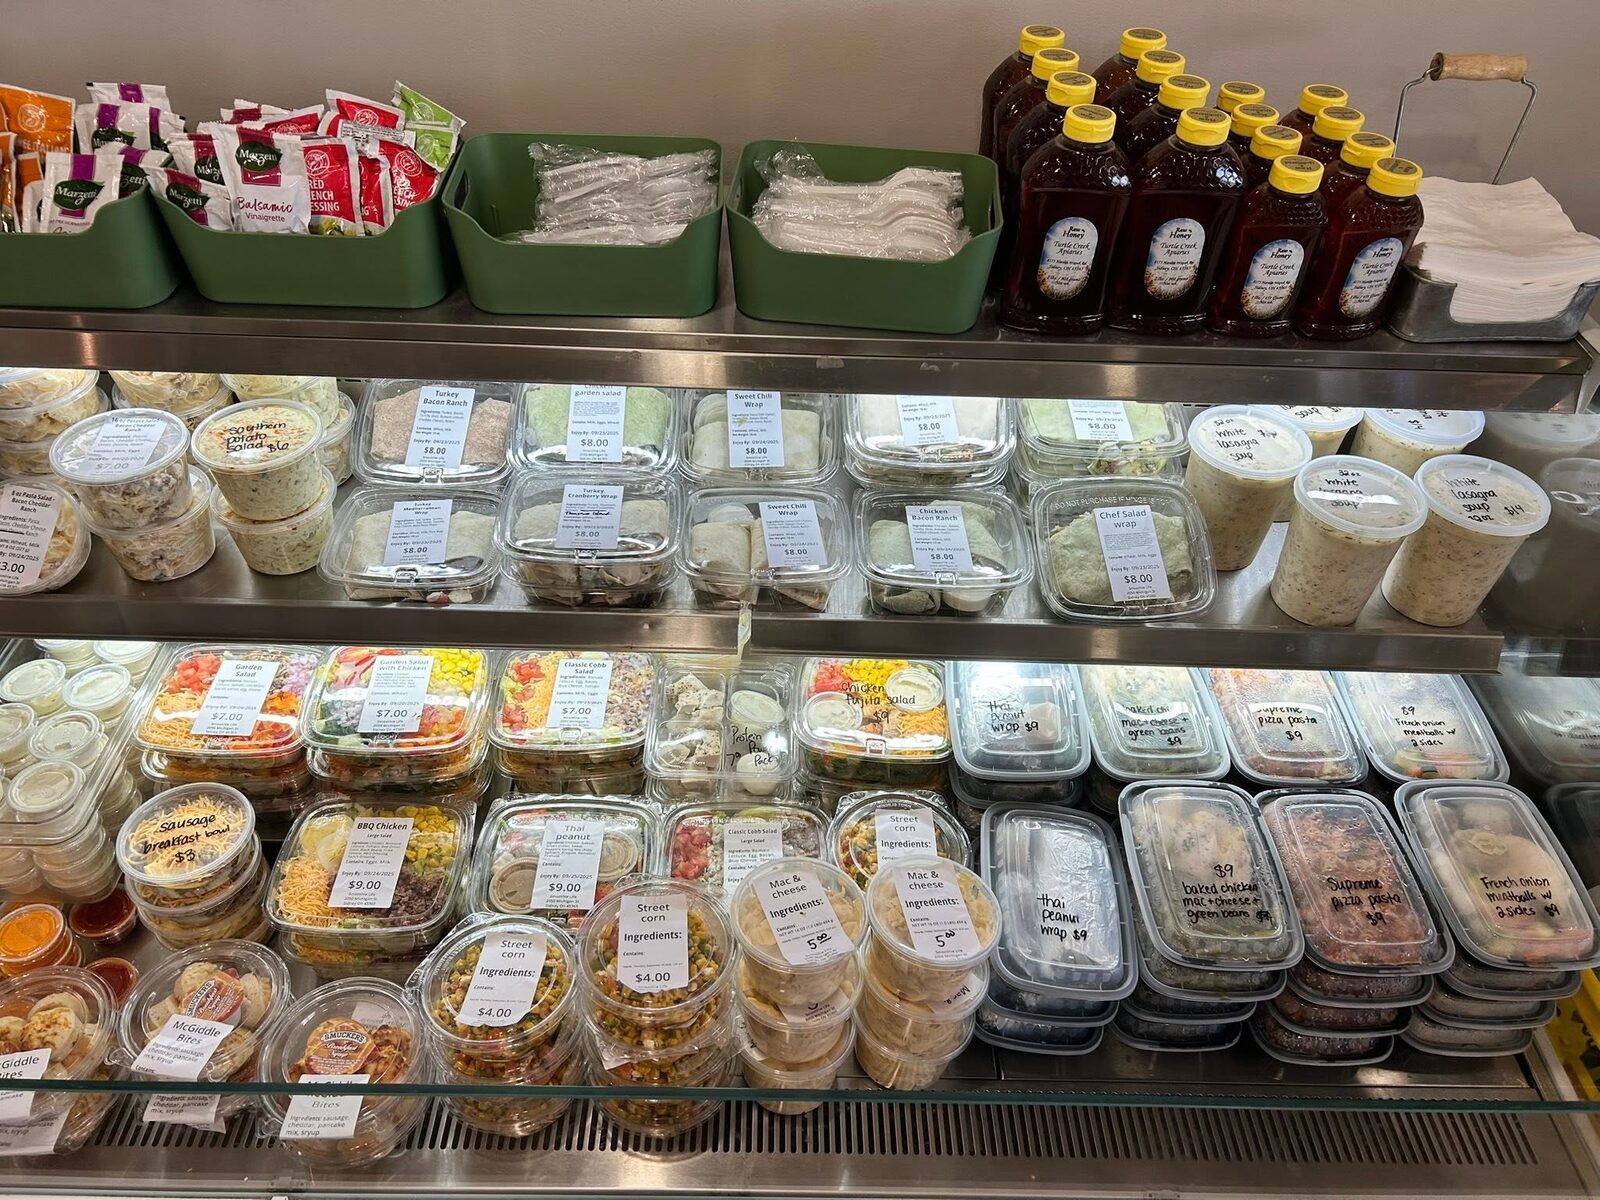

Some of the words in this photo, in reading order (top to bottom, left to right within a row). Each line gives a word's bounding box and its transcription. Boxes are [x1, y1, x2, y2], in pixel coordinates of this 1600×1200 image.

[239, 149, 277, 166] Marzetti
[309, 180, 324, 189] RED
[56, 186, 97, 205] Marzetti
[169, 189, 202, 208] Marzetti
[236, 197, 293, 213] Balsamic
[246, 213, 285, 222] Vinaigrette
[1063, 231, 1085, 239] Honey
[1054, 241, 1071, 249] Turtle
[1271, 251, 1292, 259] Honey
[1295, 407, 1322, 419] soup
[918, 422, 941, 431] $8.00
[227, 433, 267, 449] potato
[581, 438, 609, 447] $8.00
[1216, 438, 1260, 450] lasagna
[227, 442, 263, 453] salad
[267, 441, 289, 453] $6
[424, 447, 446, 455] $8.00
[1230, 452, 1255, 461] soup
[1446, 478, 1480, 487] White
[1451, 489, 1498, 501] lasagna
[28, 499, 51, 508] Cheddar
[1330, 500, 1360, 509] soup
[1462, 502, 1491, 512] soup
[1100, 511, 1120, 520] Chef
[1123, 510, 1146, 518] Salad
[886, 695, 916, 705] salad
[376, 710, 408, 718] $7.00
[562, 707, 591, 715] $7.00
[211, 713, 243, 721] $7.00
[1258, 716, 1284, 727] pizza
[1288, 716, 1318, 727] pasta
[1395, 718, 1421, 726] French
[1025, 721, 1039, 732] $9
[1167, 736, 1182, 746] $9
[1285, 731, 1303, 741] $9
[1411, 739, 1418, 747] 2
[160, 814, 216, 833] sausage
[889, 815, 920, 823] Street
[376, 822, 408, 830] Chicken
[894, 824, 917, 832] corn
[143, 832, 200, 854] breakfast
[205, 825, 230, 837] bowl
[880, 839, 932, 849] Ingredients:
[174, 849, 196, 863] $3
[769, 880, 791, 888] Mac
[793, 874, 802, 882] &
[907, 872, 928, 880] Mac
[348, 881, 381, 890] $9.00
[548, 883, 581, 893] $9.00
[909, 881, 944, 890] cheese
[1182, 881, 1218, 894] baked
[1221, 882, 1258, 893] chicken
[1480, 876, 1518, 890] French
[1520, 876, 1550, 887] onion
[772, 884, 807, 899] cheese
[905, 898, 960, 909] Ingredients:
[1331, 896, 1363, 912] pizza
[1368, 892, 1402, 910] pasta
[637, 904, 670, 912] Street
[769, 898, 824, 919] Ingredients:
[1496, 906, 1505, 918] 2
[1506, 905, 1536, 916] sides
[641, 914, 666, 922] corn
[1187, 909, 1219, 923] green
[1220, 910, 1250, 918] beans
[624, 931, 682, 943] Ingredients:
[1040, 925, 1067, 942] wrap
[501, 940, 533, 949] Street
[635, 972, 671, 983] $4.00
[477, 1008, 512, 1018] $4.00
[173, 1021, 221, 1037] McGiddle
[176, 1034, 202, 1045] Bites
